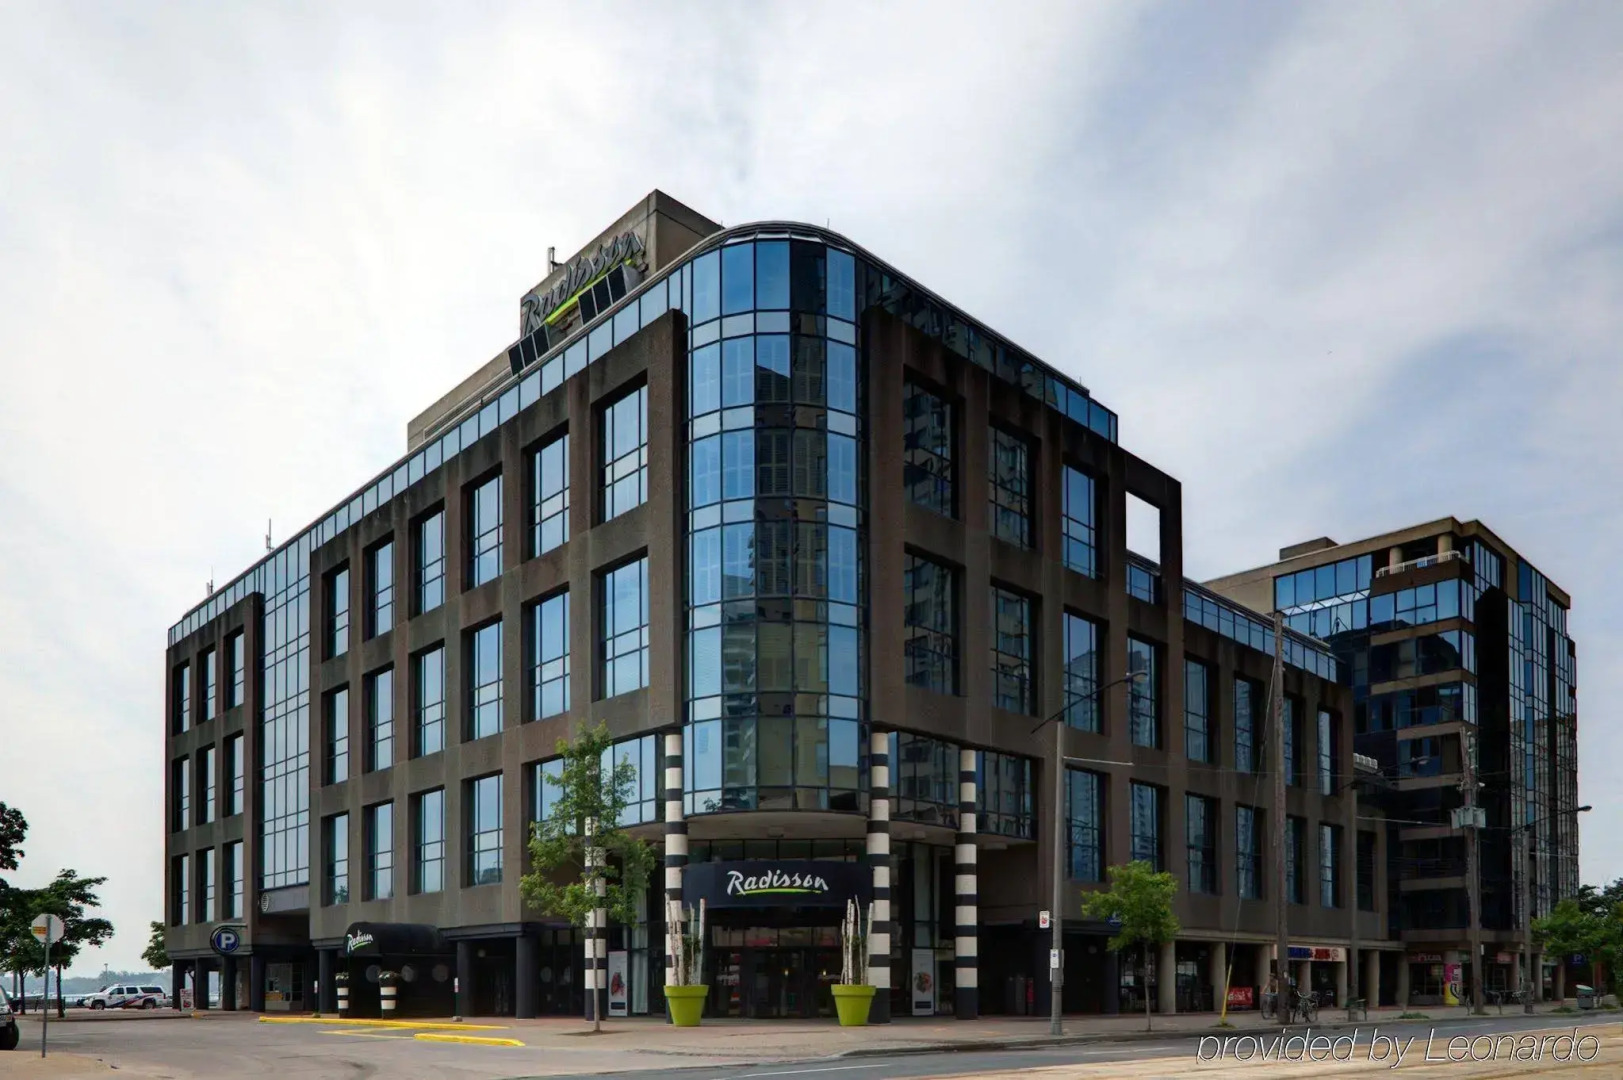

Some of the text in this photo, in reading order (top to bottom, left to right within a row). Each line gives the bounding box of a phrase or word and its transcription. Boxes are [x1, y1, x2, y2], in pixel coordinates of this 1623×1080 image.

[522, 231, 645, 337] Radisson
[727, 869, 829, 895] Radisson
[221, 932, 235, 949] P
